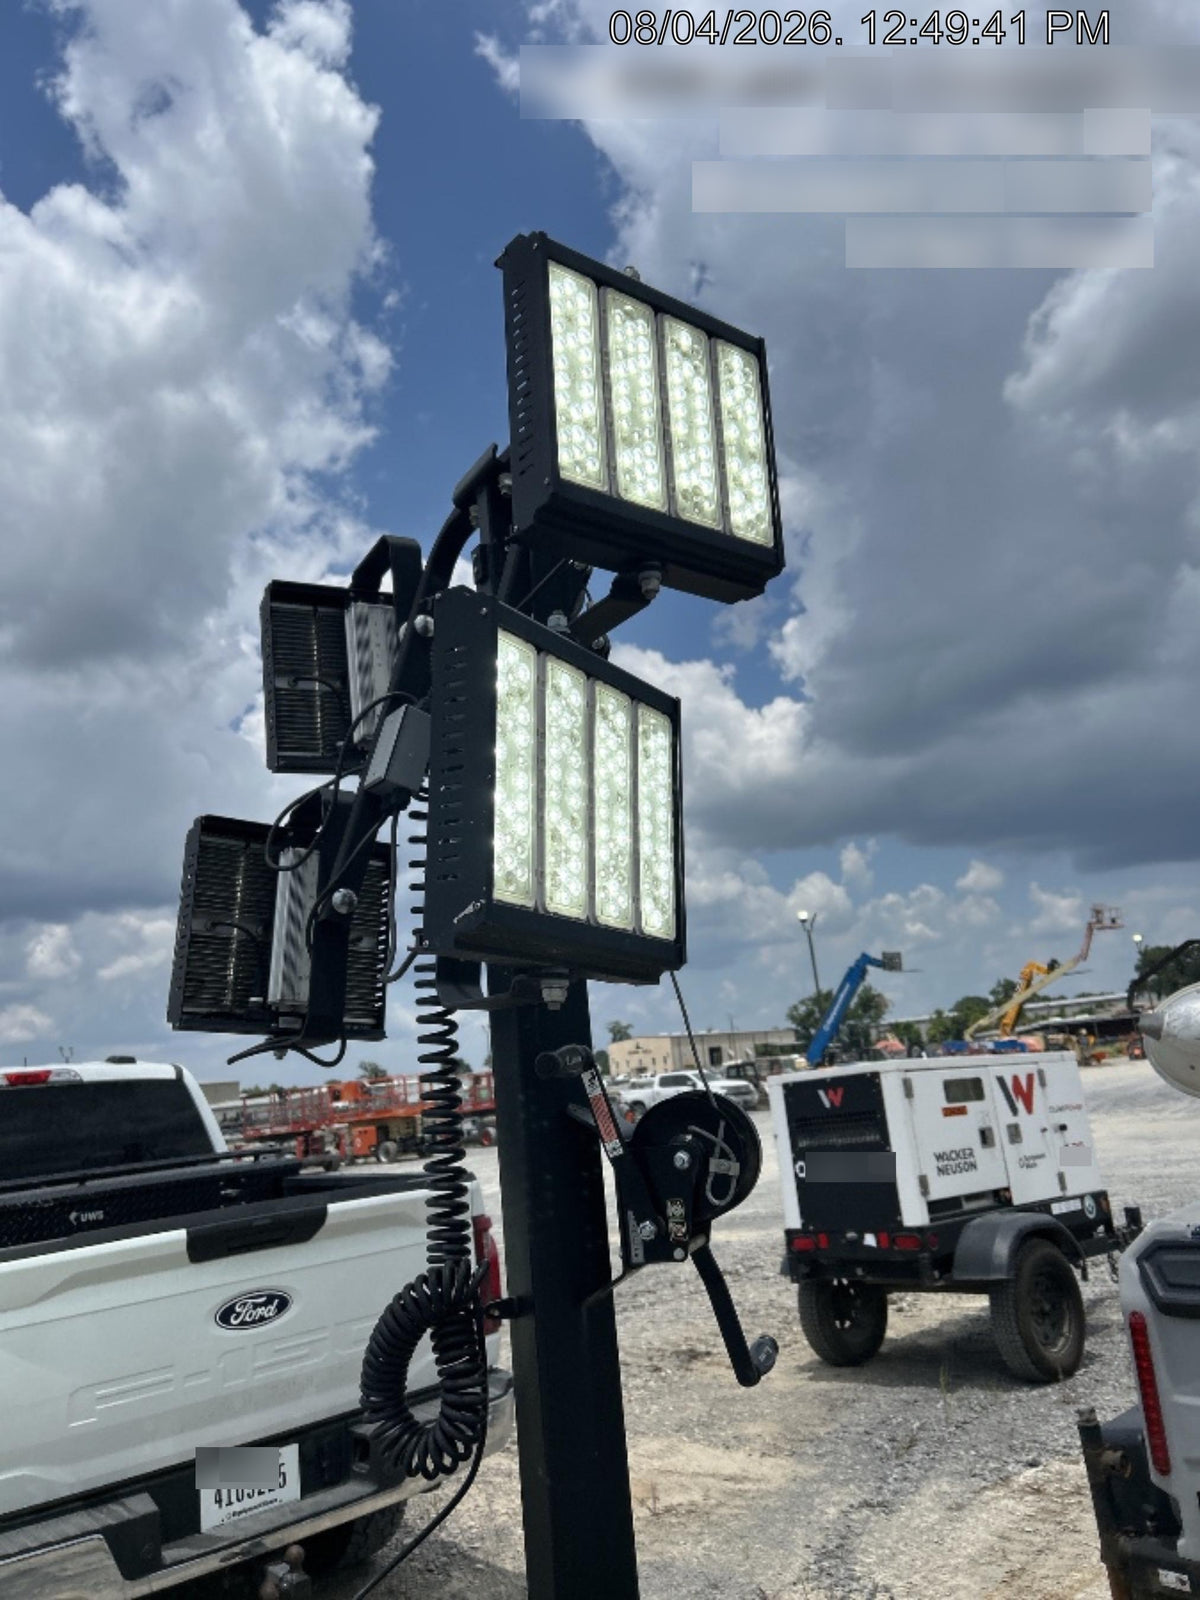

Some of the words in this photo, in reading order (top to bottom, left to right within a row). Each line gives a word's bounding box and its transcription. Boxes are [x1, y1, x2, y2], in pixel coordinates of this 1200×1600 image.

[933, 1148, 975, 1163] WACKER
[936, 1160, 978, 1177] NEUSON
[80, 1210, 104, 1223] UWS
[230, 1296, 280, 1325] Ford
